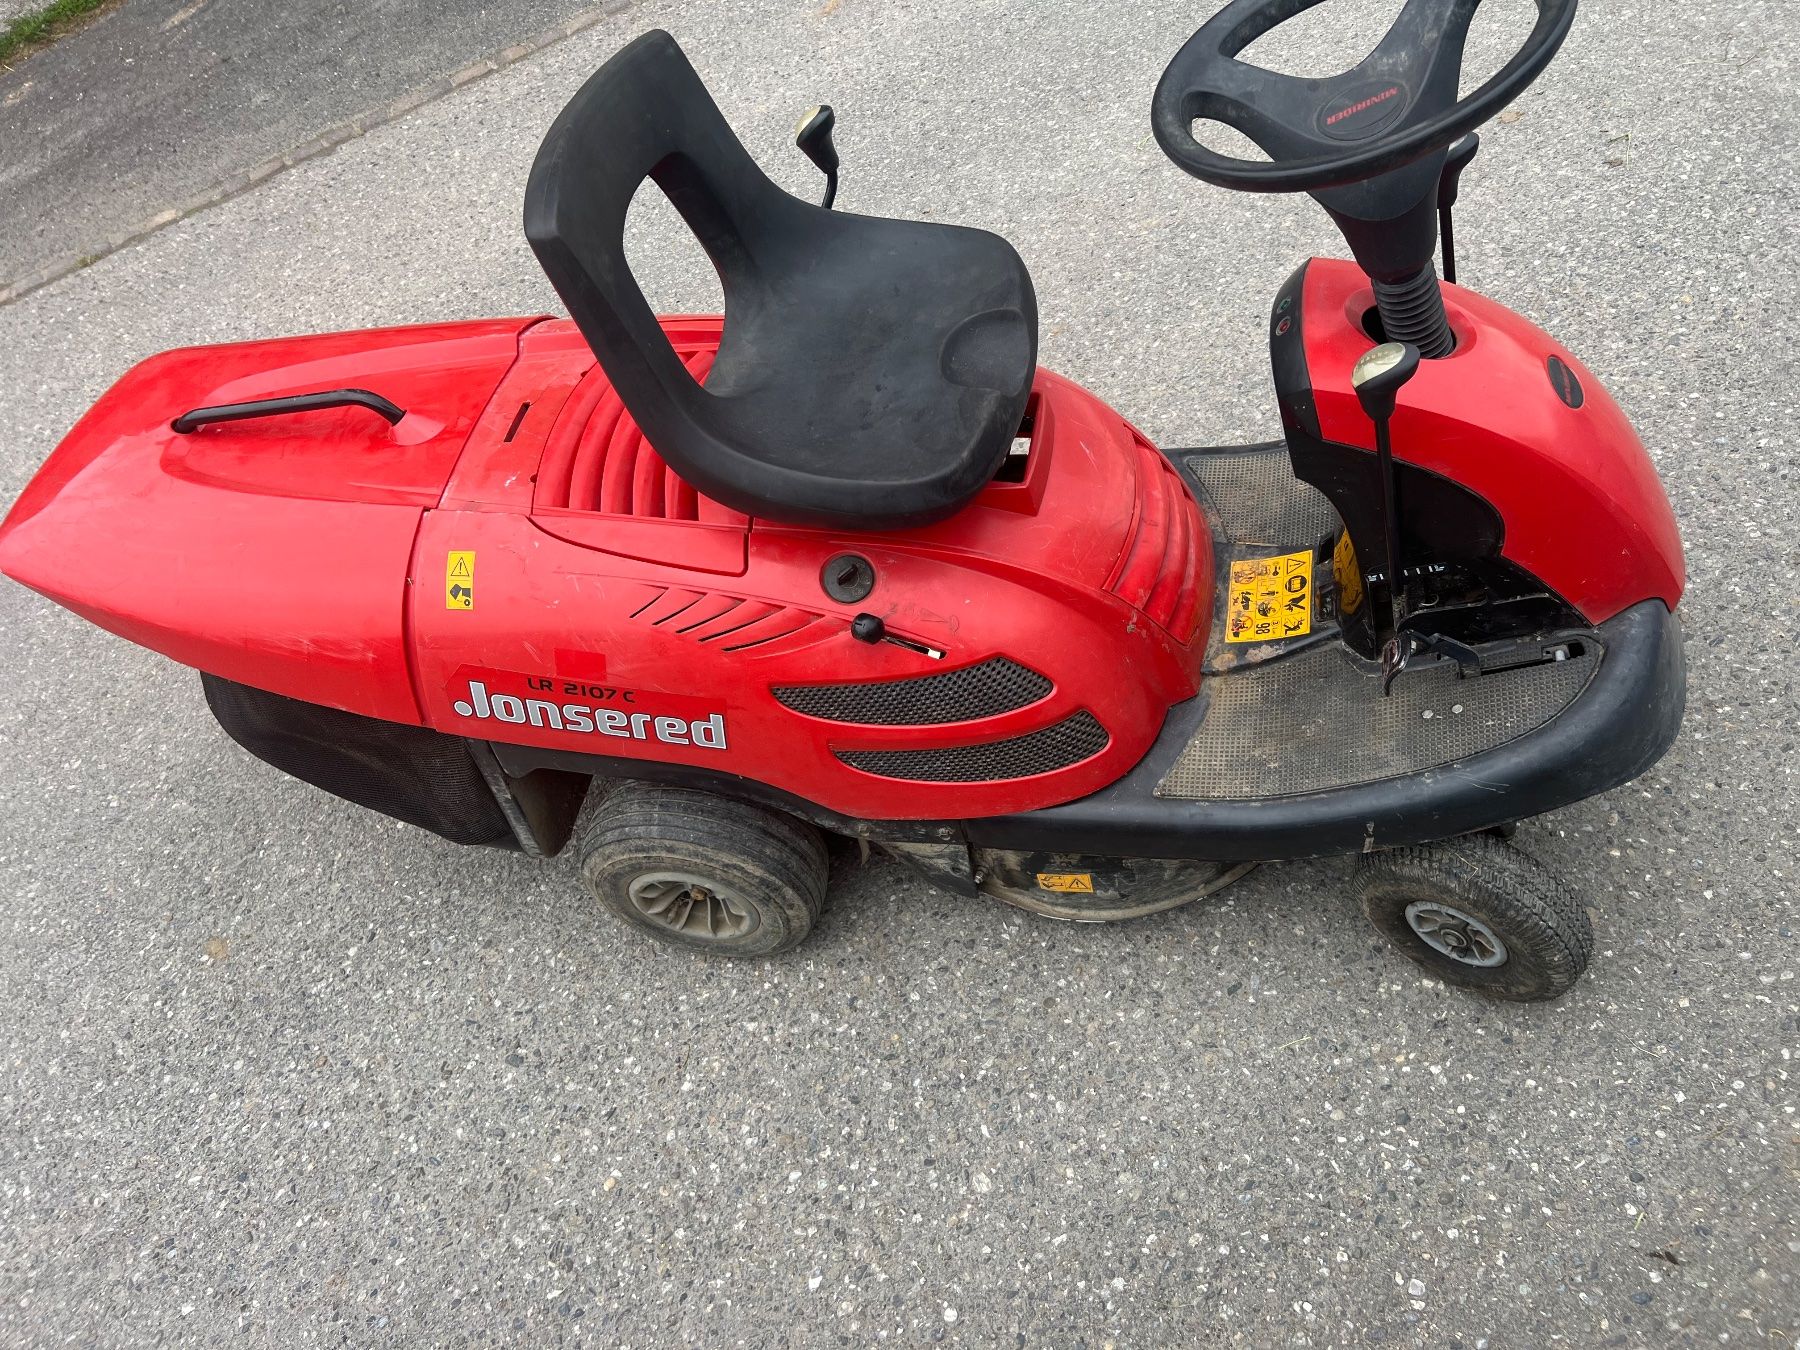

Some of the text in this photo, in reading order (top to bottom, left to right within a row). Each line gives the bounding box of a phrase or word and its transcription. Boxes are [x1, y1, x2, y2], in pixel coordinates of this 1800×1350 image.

[1326, 87, 1399, 125] MINIRIDER
[1256, 622, 1270, 635] 98
[527, 678, 635, 703] LR 2107 C
[454, 680, 727, 750] Jonsered
